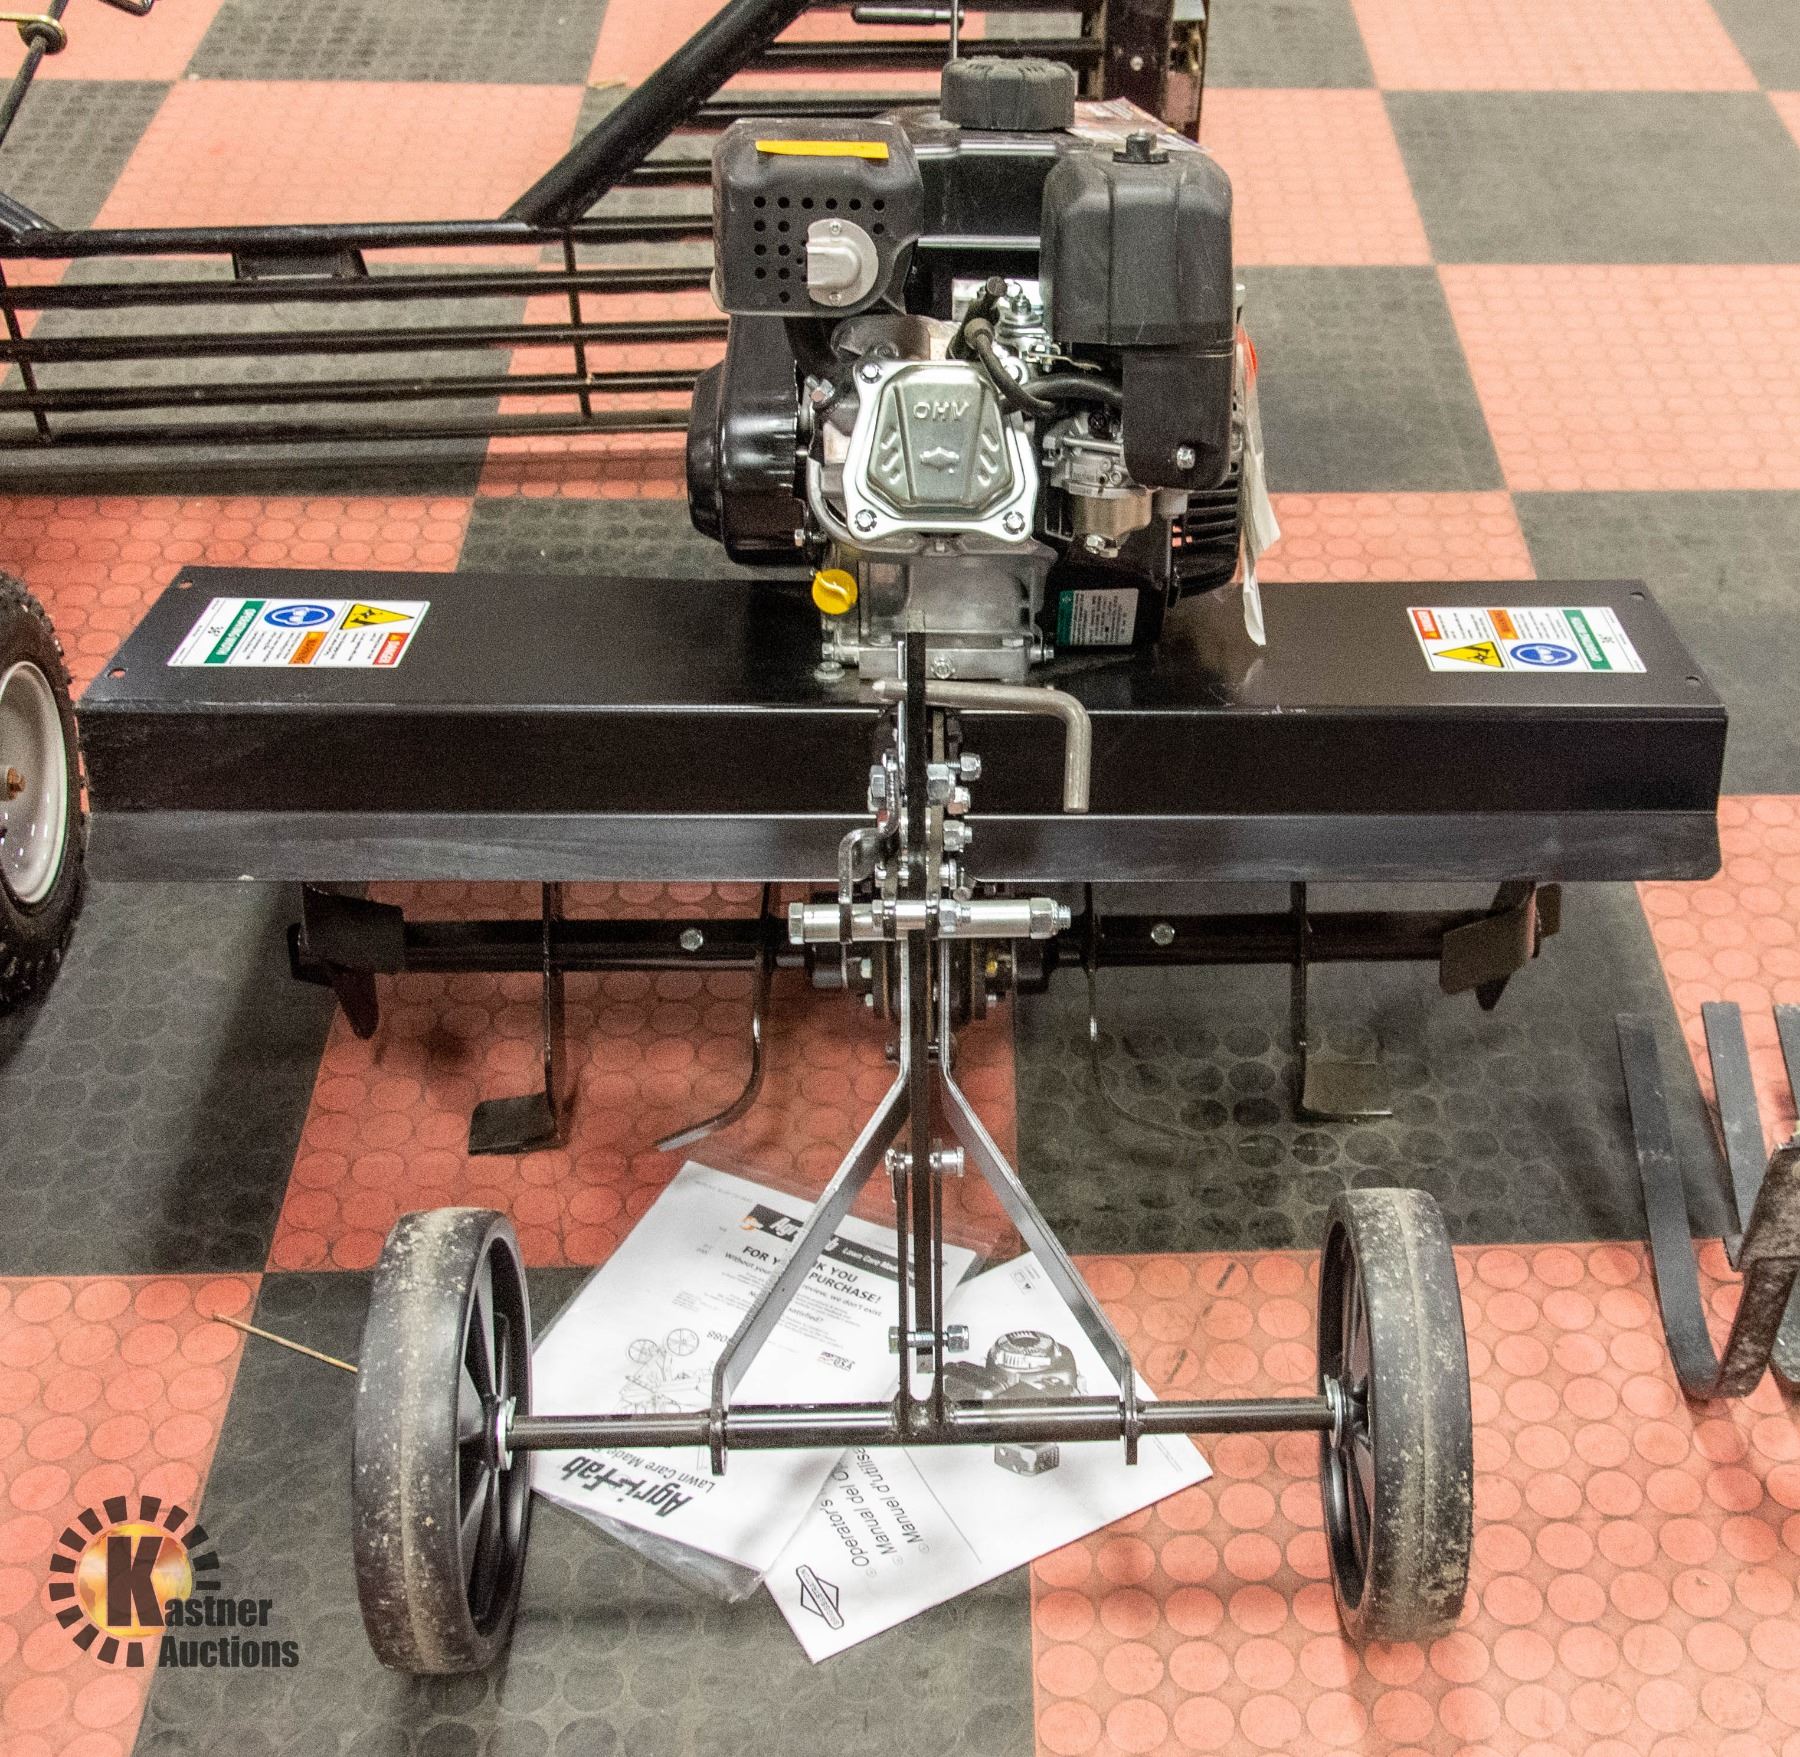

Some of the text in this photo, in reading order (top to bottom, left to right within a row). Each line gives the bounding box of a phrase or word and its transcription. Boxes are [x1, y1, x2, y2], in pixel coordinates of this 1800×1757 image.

[913, 400, 970, 420] OHV
[742, 1246, 769, 1262] FOR
[808, 1271, 882, 1304] PURCHASE!
[830, 1266, 859, 1283] YOU
[560, 1456, 693, 1517] Agri-Fab
[606, 1448, 716, 1494] Lawn Care Made
[840, 1483, 865, 1504] del
[820, 1499, 870, 1567] Operator's
[853, 1508, 897, 1555] Manual
[880, 1496, 924, 1544] Manuel
